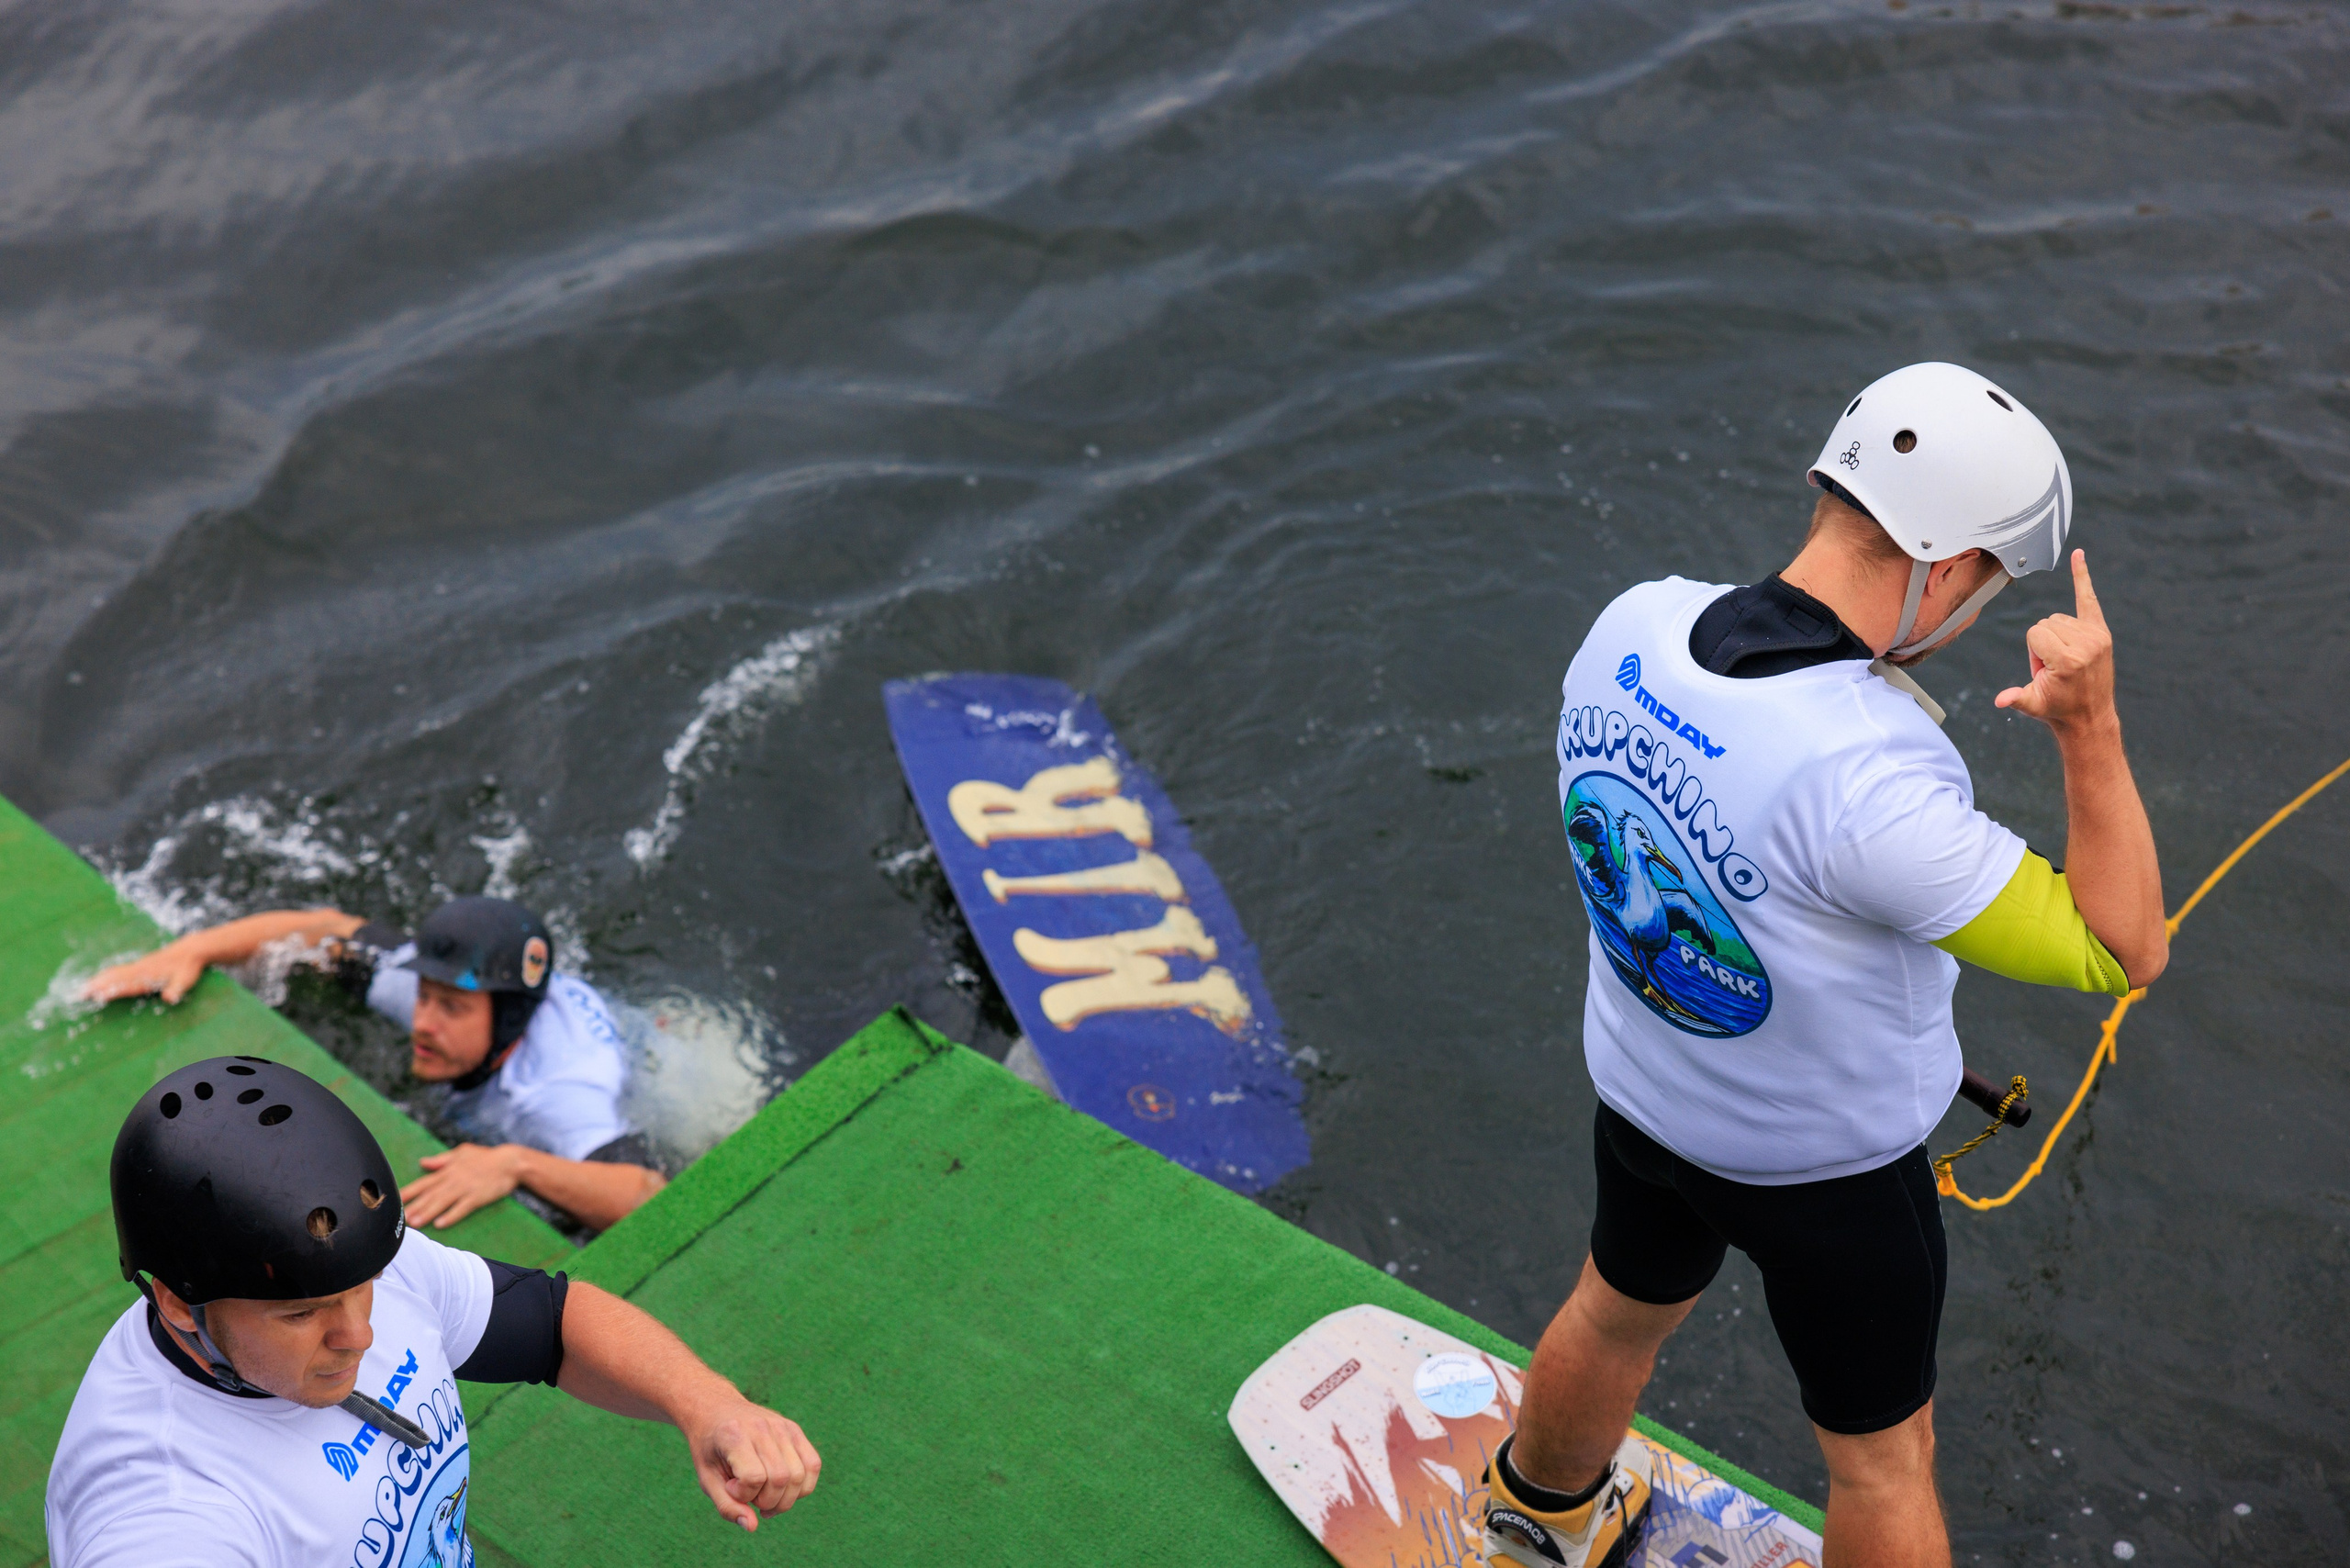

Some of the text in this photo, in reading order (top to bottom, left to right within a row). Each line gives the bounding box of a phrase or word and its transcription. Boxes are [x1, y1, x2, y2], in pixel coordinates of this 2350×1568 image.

[1634, 685, 1727, 760] MDAY
[1560, 705, 1768, 902] KUPCHINO
[947, 755, 1255, 1042] MIR
[1679, 945, 1761, 999] PARK
[1300, 1358, 1361, 1411] SLINGSHOT
[1492, 1511, 1547, 1545] SPACEMOB
